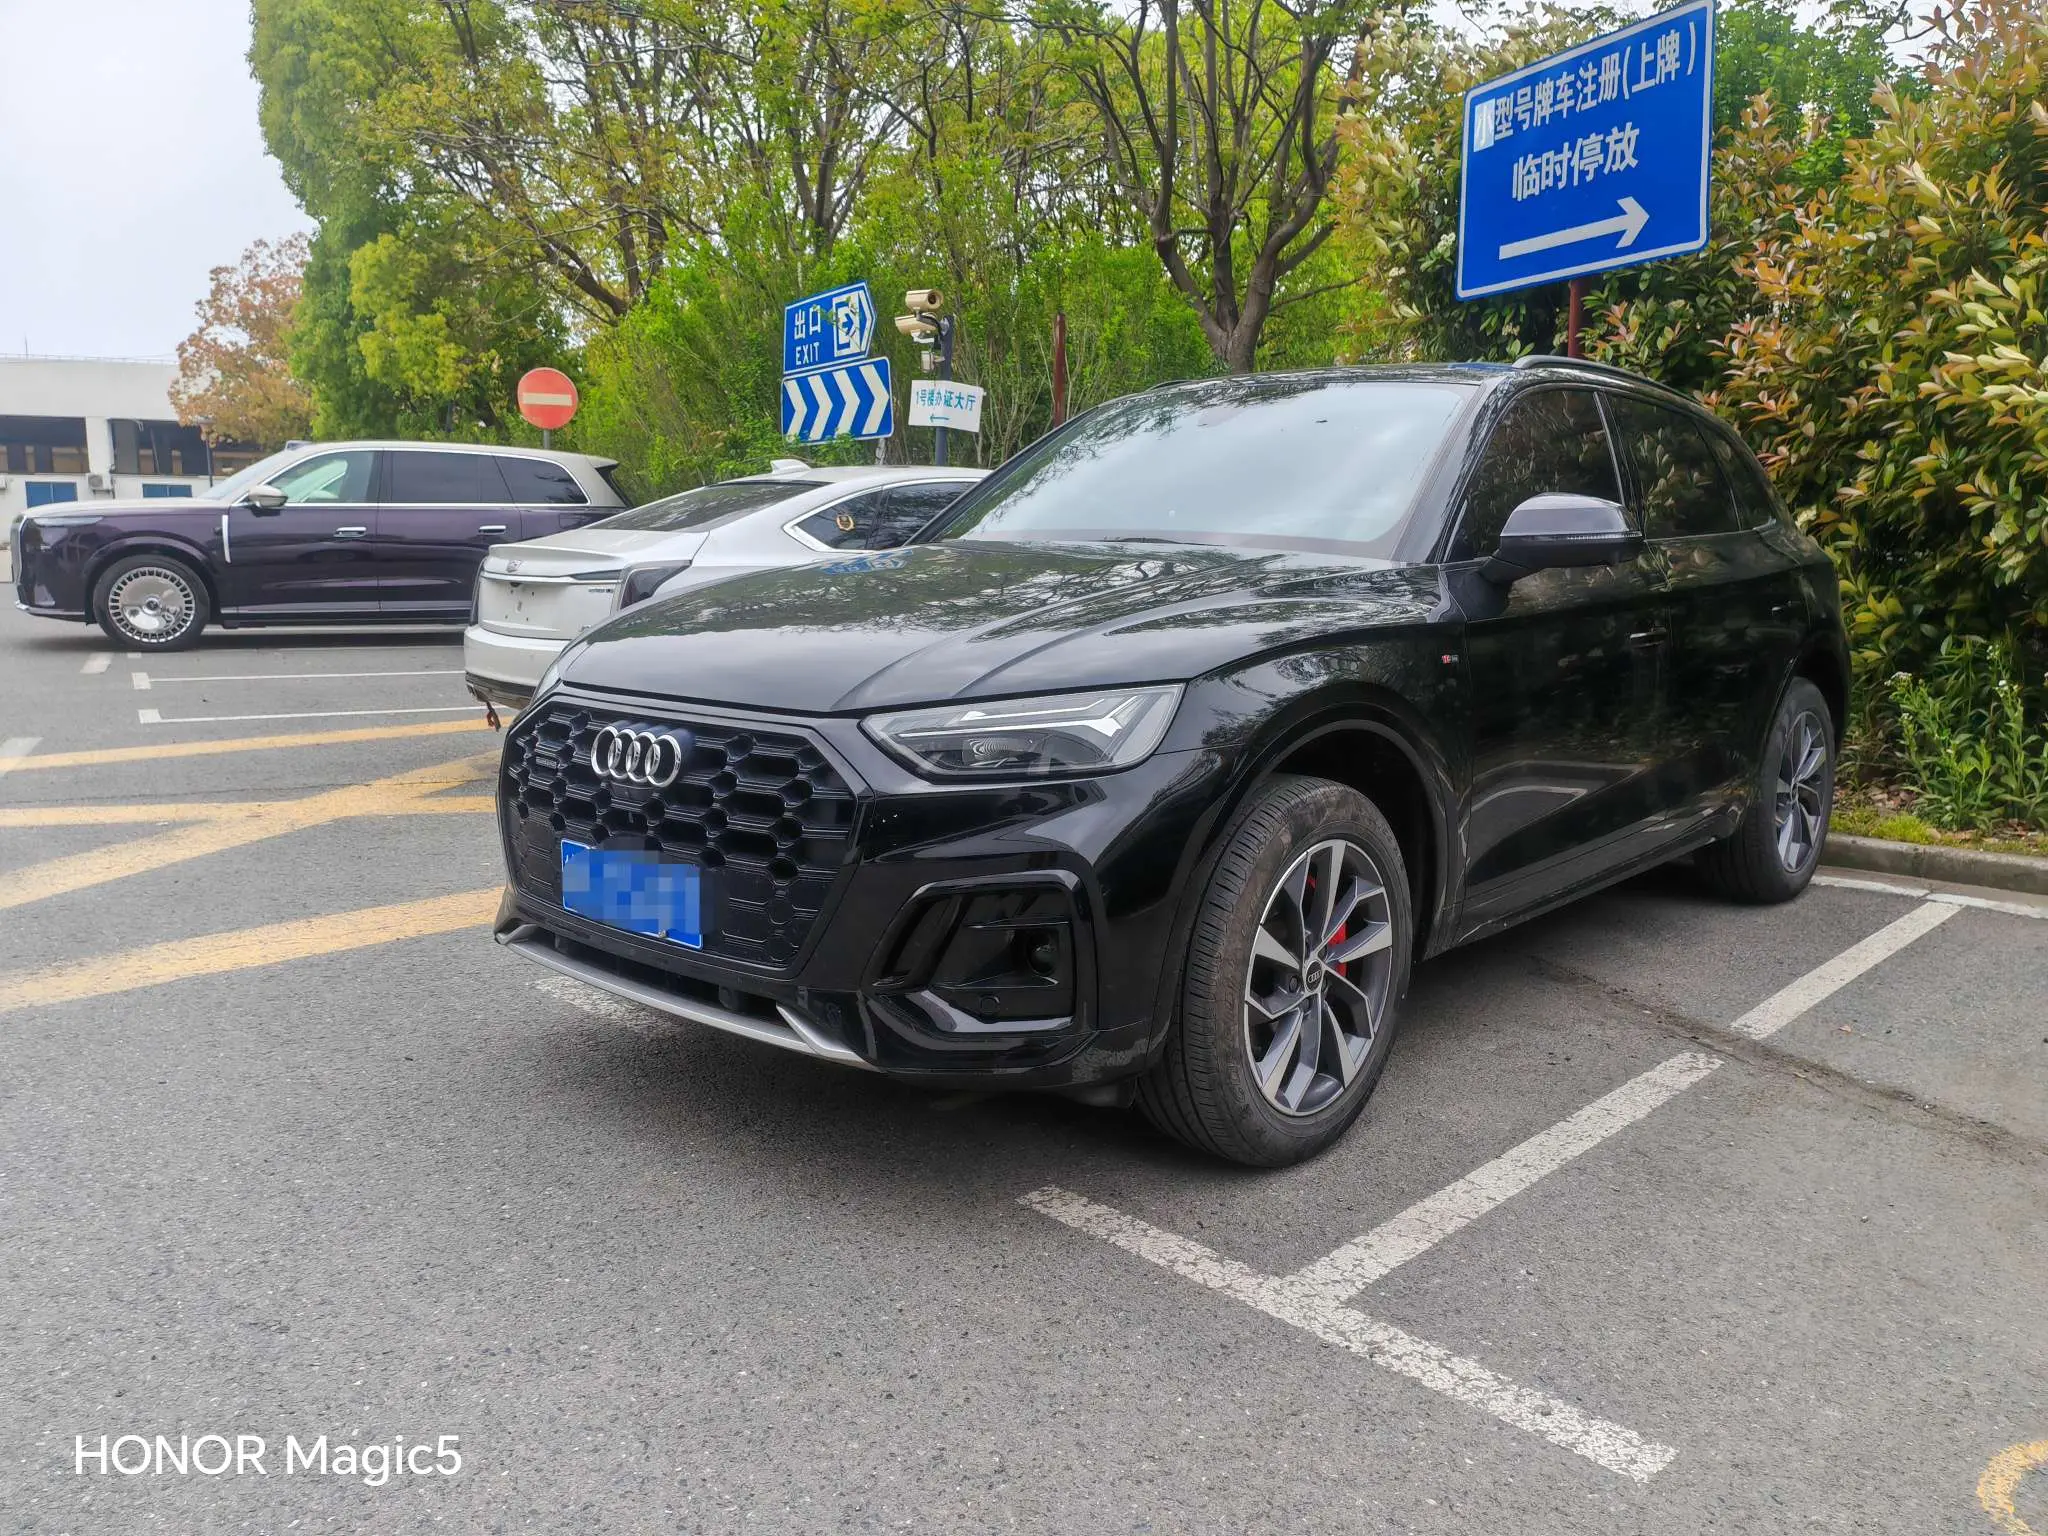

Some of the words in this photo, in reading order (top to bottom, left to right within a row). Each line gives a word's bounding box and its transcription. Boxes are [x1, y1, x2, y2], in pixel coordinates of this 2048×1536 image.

[1512, 121, 1640, 201] 临时停放
[793, 304, 822, 340] 出口
[795, 341, 819, 366] EXIT
